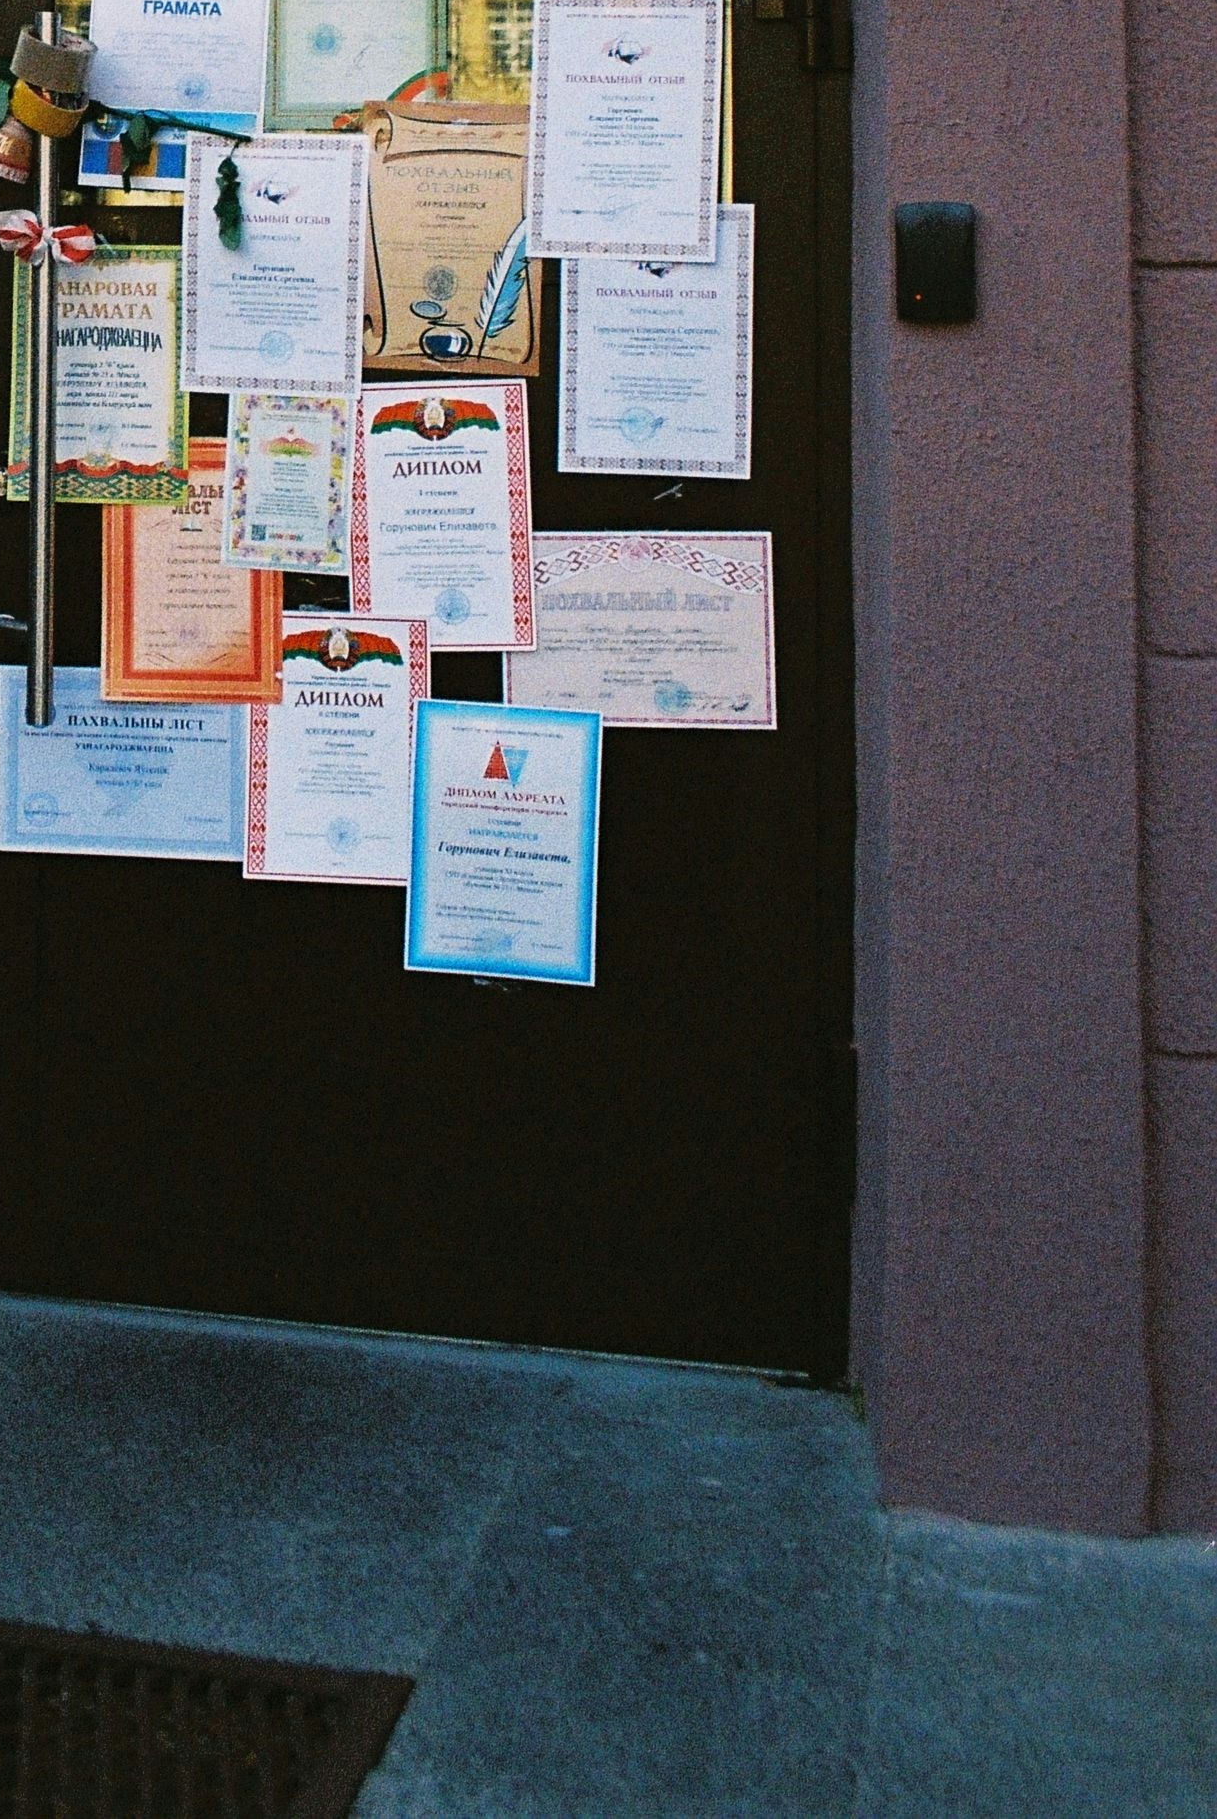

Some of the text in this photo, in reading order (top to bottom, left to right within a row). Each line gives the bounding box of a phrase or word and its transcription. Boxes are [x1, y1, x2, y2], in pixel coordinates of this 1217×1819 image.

[142, 0, 222, 17] ГРАМАТА
[565, 71, 643, 85] ПОХВАЛЬНЫЙ
[57, 281, 157, 297] АНАРОВАЯ
[596, 287, 718, 300] ПОХВАЛЬНЫЙ ОТЗЫВ
[59, 302, 153, 319] РАМАТА
[392, 460, 482, 479] ДИПЛОМ
[379, 522, 436, 534] Горунович
[294, 689, 384, 708] ДИПЛОМ
[67, 715, 206, 731] ПАХВАЛЬНЫ ЛІСТ
[444, 786, 565, 805] ДИПЛОМ ЛАУРЕАТА
[438, 841, 572, 864] Горунович Елизавета,
